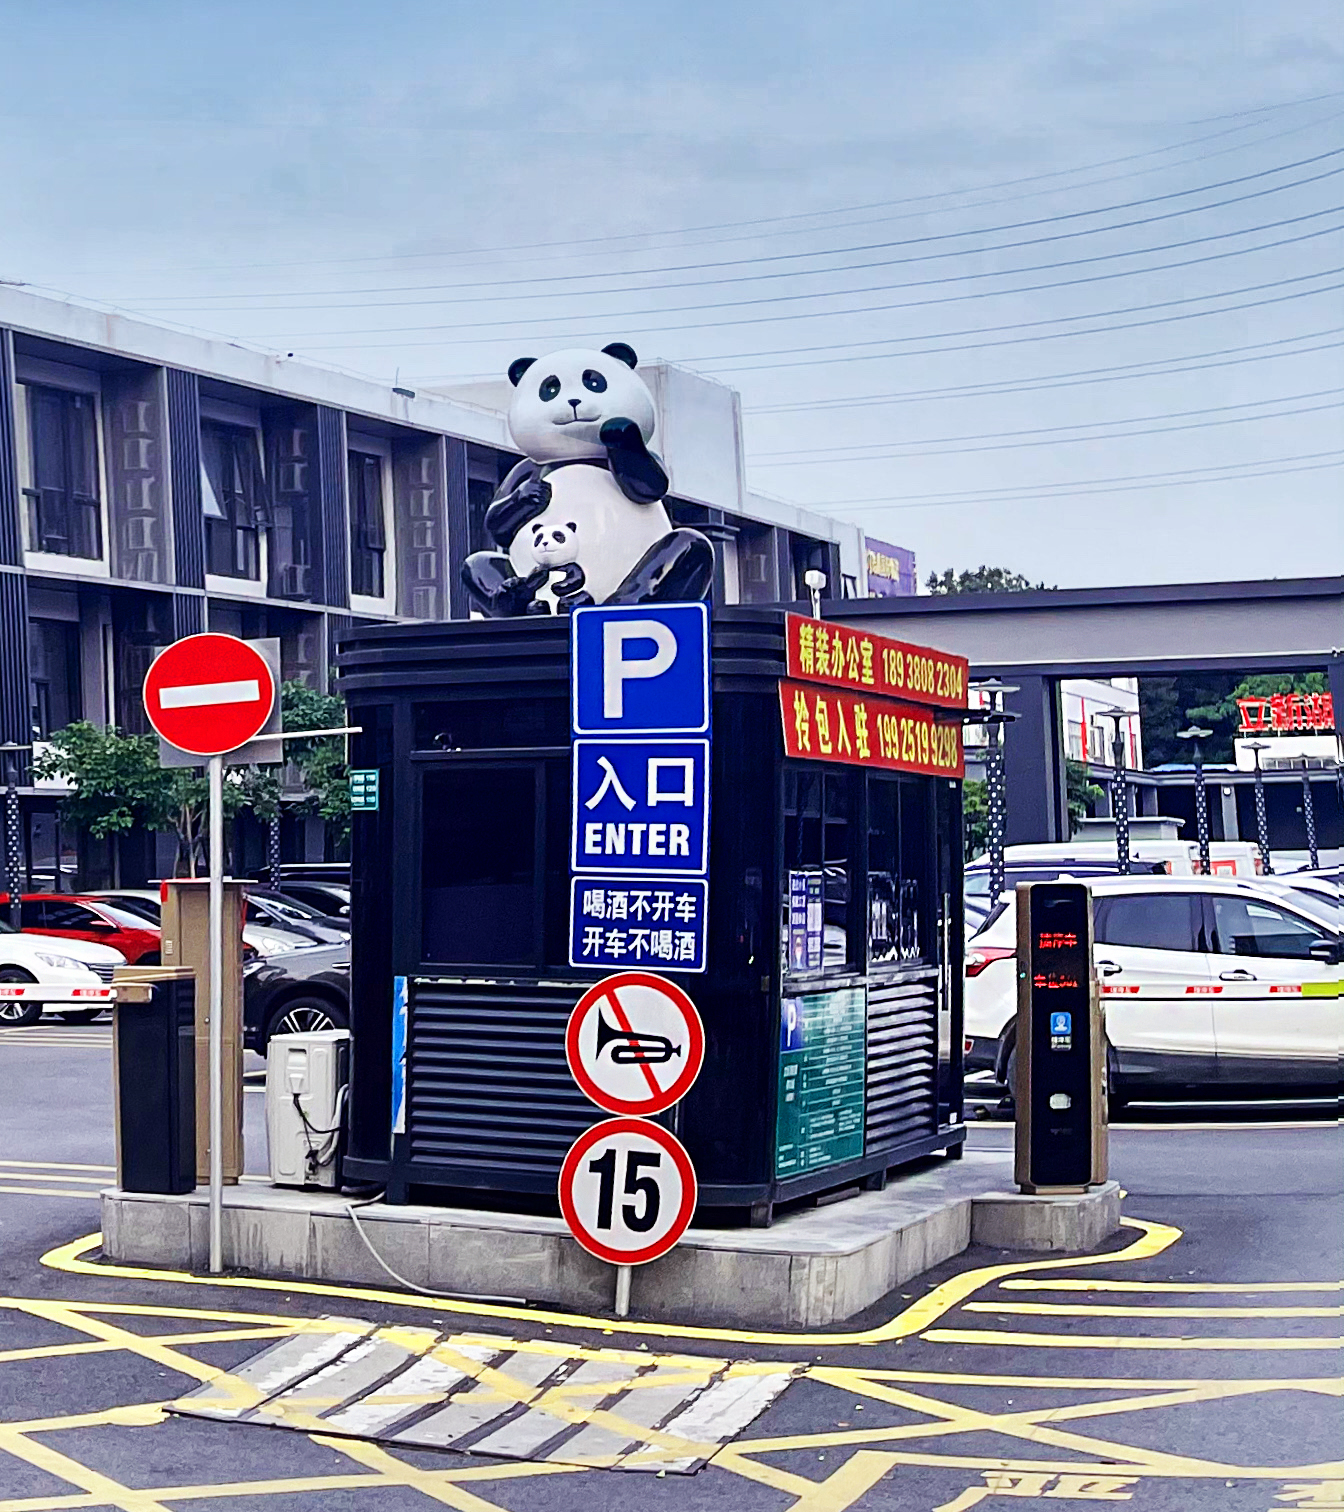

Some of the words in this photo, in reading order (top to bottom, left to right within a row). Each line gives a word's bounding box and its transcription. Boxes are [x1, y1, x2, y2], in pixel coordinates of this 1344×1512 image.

[603, 619, 678, 719] P
[799, 623, 875, 684] 精装办公室
[793, 690, 871, 759] 拎包入驻
[584, 755, 695, 812] 入口
[584, 822, 690, 857] ENTER
[582, 889, 697, 923] 喝酒不开车
[582, 926, 696, 961] 开车不喝酒
[588, 1148, 662, 1233] 15
